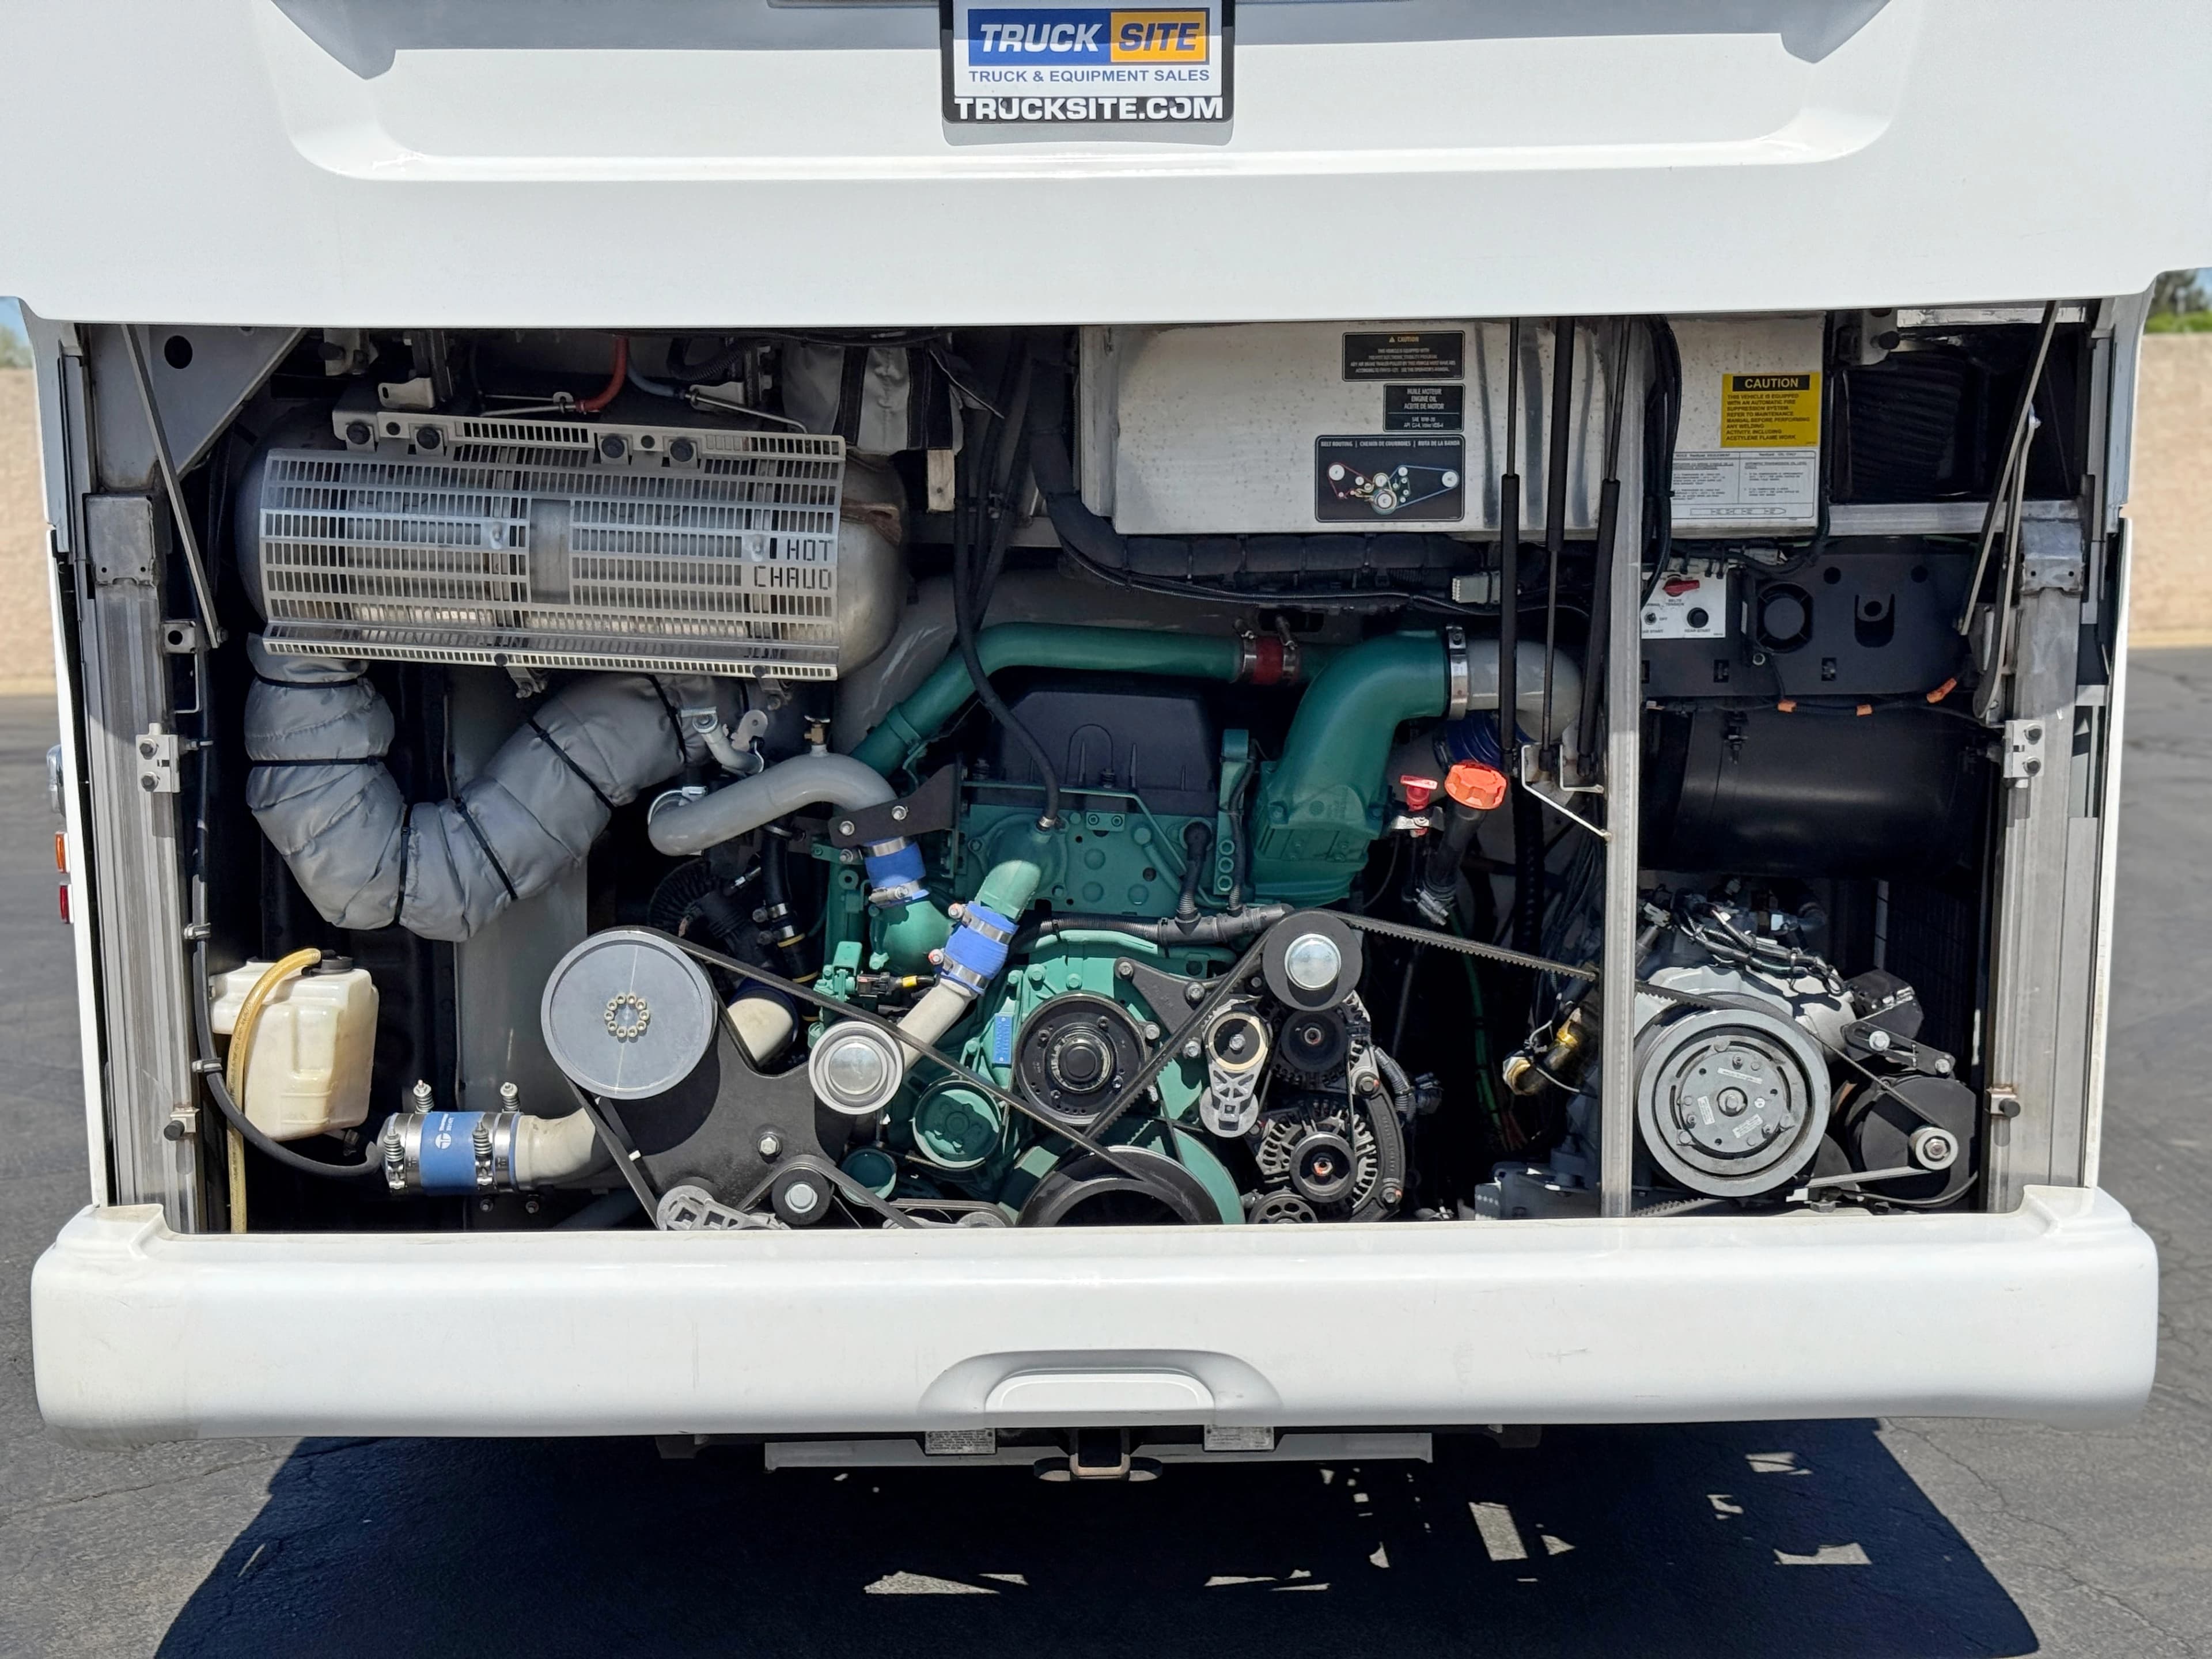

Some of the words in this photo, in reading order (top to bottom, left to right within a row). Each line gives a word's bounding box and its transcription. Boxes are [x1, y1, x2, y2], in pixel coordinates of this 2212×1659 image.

[980, 24, 1102, 53] TRUCK
[1119, 22, 1201, 51] SITE
[969, 70, 1027, 82] TRUCK
[1033, 70, 1044, 82] &
[1050, 70, 1149, 82] EQUIPMENT
[1154, 69, 1210, 82] SALES
[954, 97, 1223, 120] TRUCKSITE.COM
[1744, 377, 1798, 389] CAUTION
[787, 539, 834, 561] HOT
[754, 566, 832, 590] CHAUD
